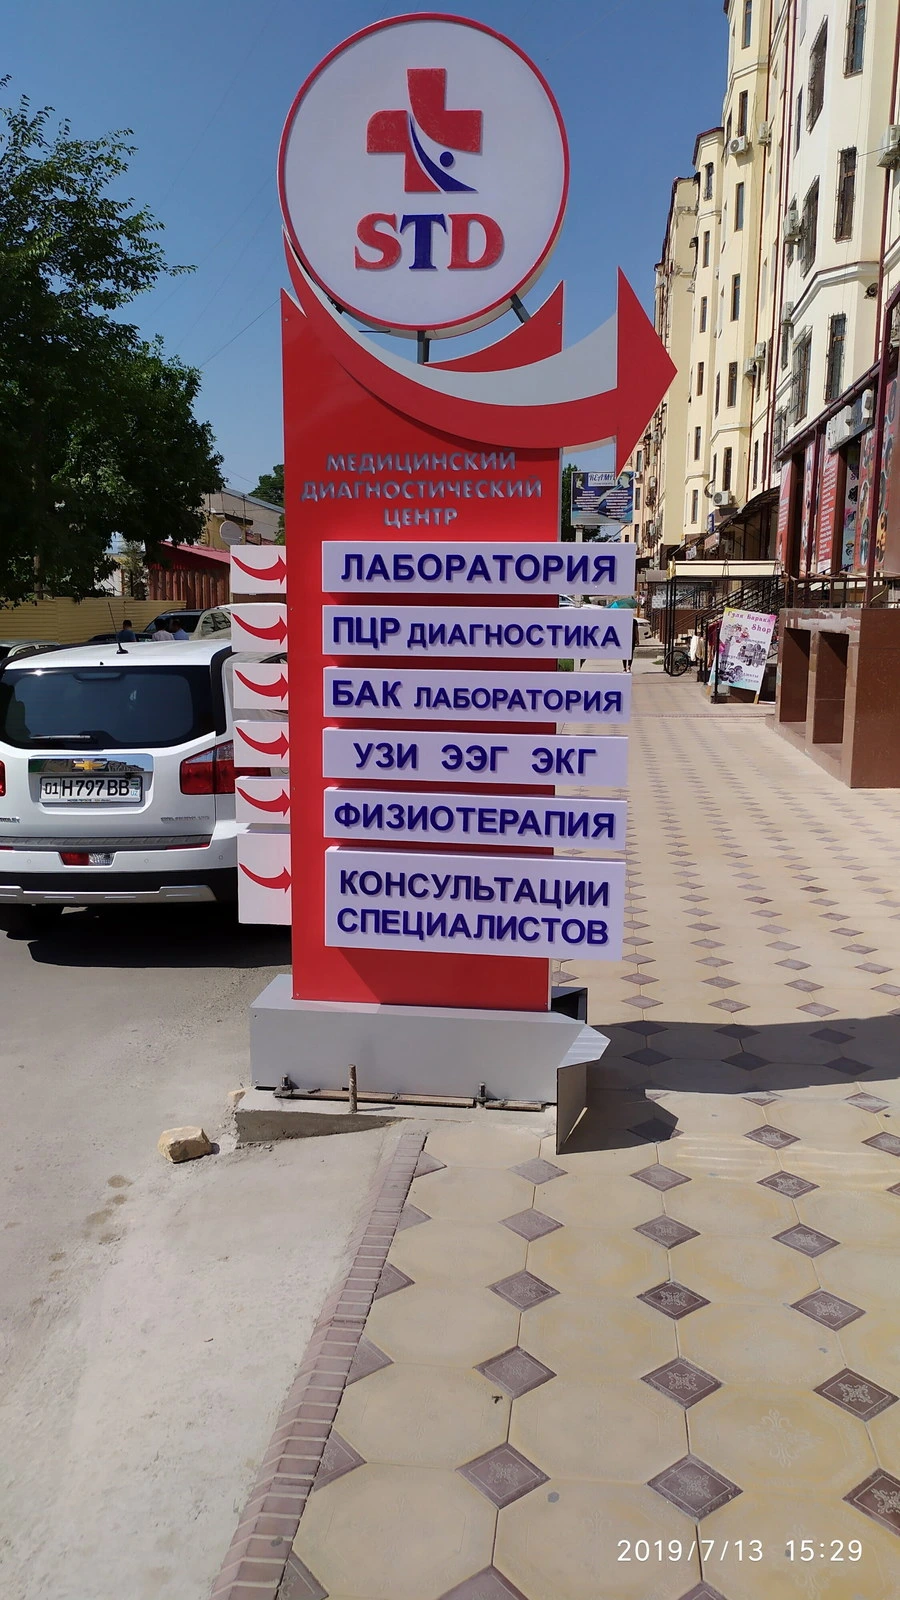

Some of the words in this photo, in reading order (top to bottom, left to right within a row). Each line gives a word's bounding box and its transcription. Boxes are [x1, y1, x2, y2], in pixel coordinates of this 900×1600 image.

[354, 212, 504, 270] STD
[327, 449, 516, 474] МЕДИЦИНСКИЙ
[301, 475, 542, 501] ДИАГНОСТИЧЕСКИЙ
[383, 508, 458, 528] ЦЕНТР
[341, 553, 617, 583] ЛАБОРАТОРИЯ
[333, 616, 400, 649] ПЦР
[407, 622, 621, 649] ДИАГНОСТИКА
[751, 624, 771, 634] Shop
[332, 680, 402, 708] БАК
[414, 686, 622, 712] ЛАБОРАТОРИЯ
[353, 742, 418, 769] УЗИ
[441, 744, 508, 772] ЭЭГ
[531, 747, 596, 774] ЭКГ
[44, 783, 59, 795] 01
[334, 802, 615, 839] ФИЗИОТЕРАПИЯ
[339, 869, 609, 909] КОНСУЛЬТАЦИИ
[336, 907, 609, 945] СПЕЦИАЛИСТОВ
